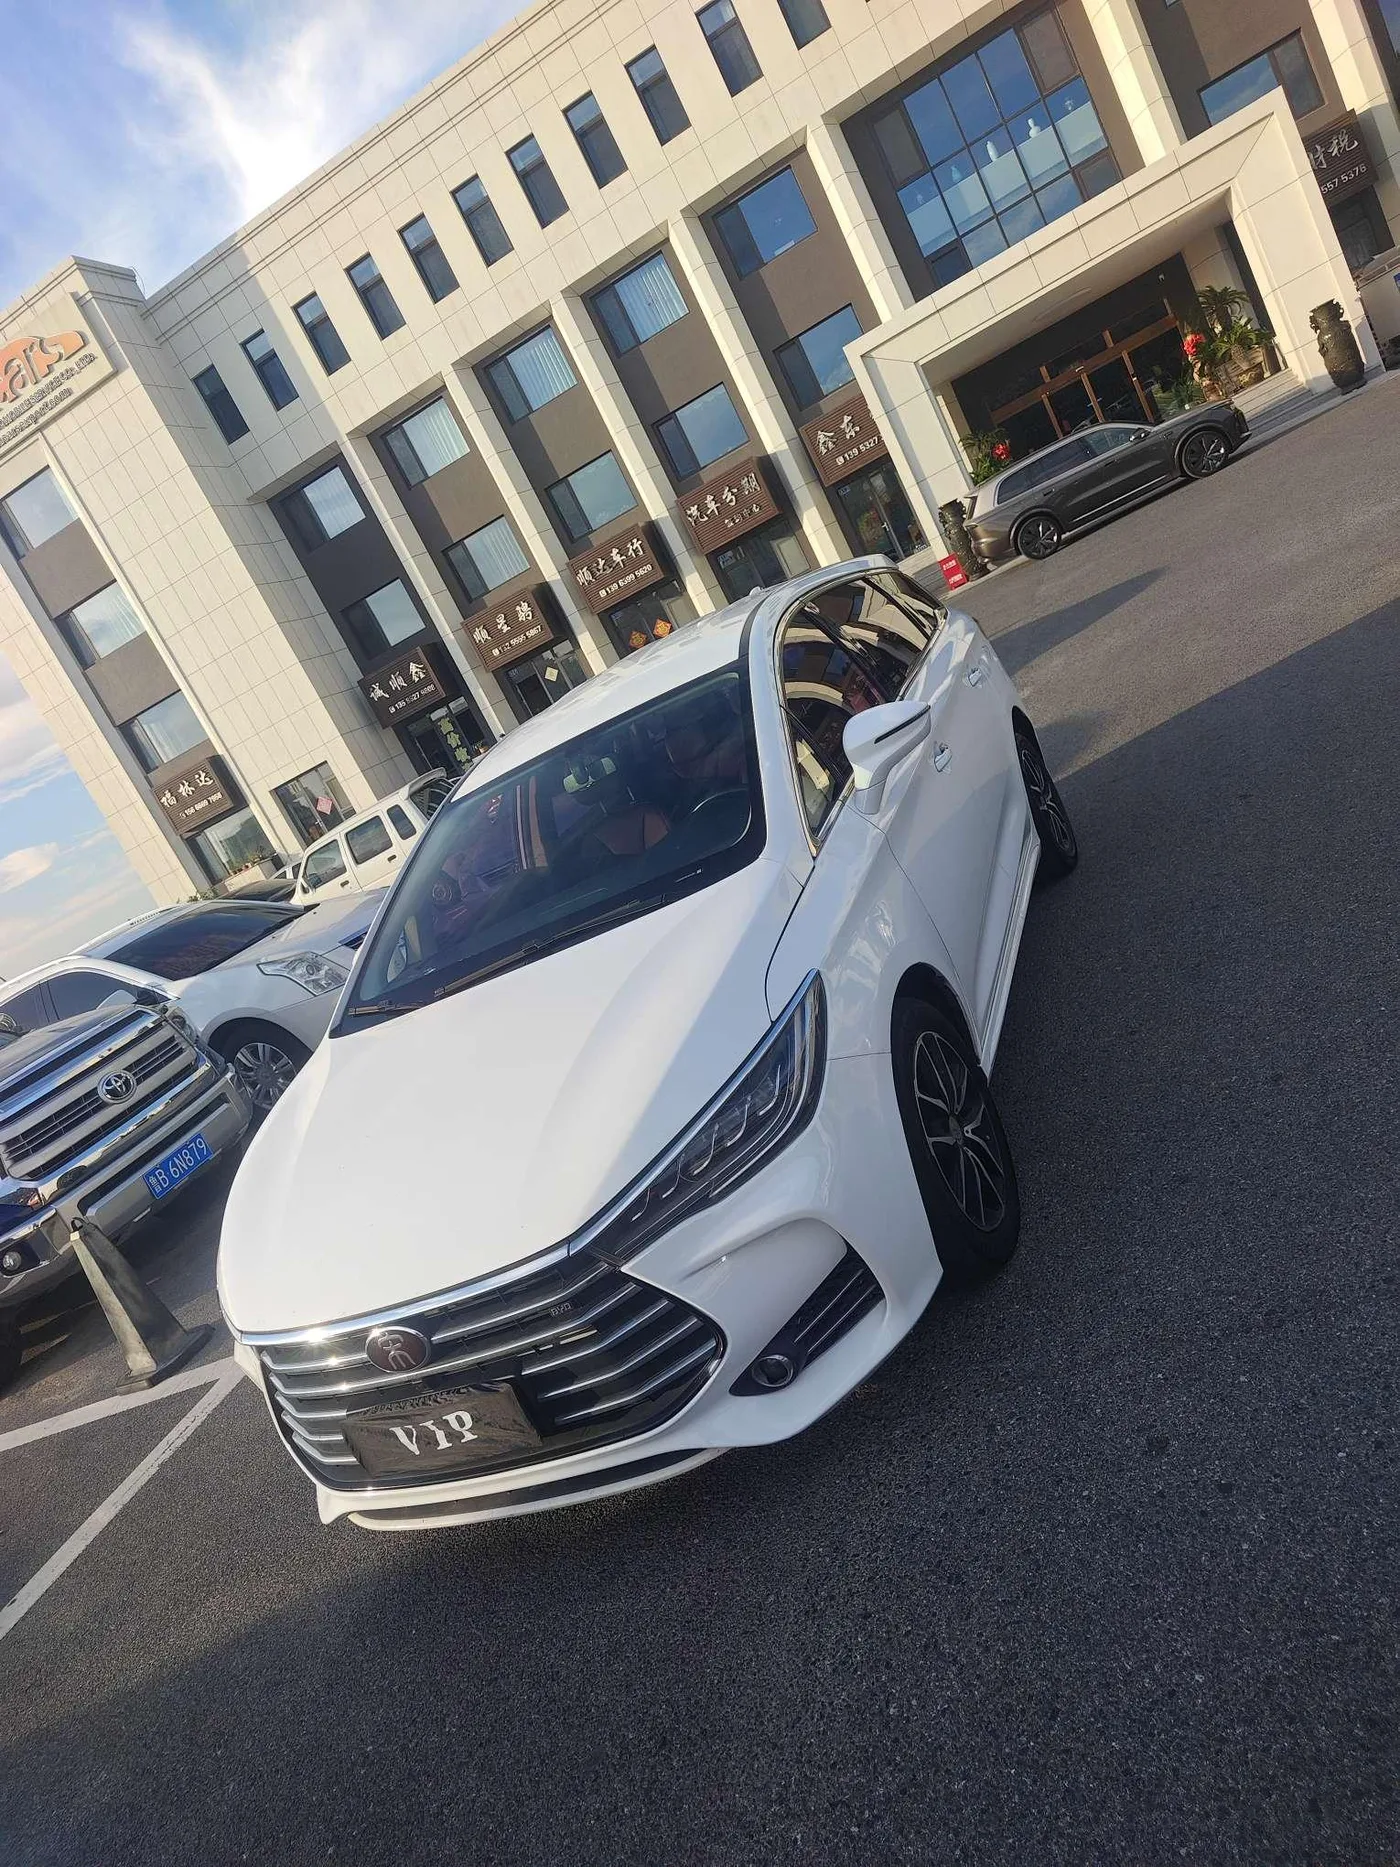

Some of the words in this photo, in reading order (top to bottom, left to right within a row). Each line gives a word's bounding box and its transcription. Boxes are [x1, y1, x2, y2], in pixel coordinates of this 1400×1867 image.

[1340, 163, 1367, 183] 5376
[844, 448, 859, 461] 139
[859, 436, 879, 452] 5327
[685, 472, 761, 526] 汽车分期
[576, 538, 644, 586] 顺达车行
[606, 583, 619, 594] 139
[635, 564, 653, 578] 5620
[526, 625, 542, 638] 5867
[369, 662, 426, 702] 诚顺鑫
[394, 699, 407, 710] 135
[160, 770, 214, 808] 福林达
[550, 1302, 571, 1317] BYD
[389, 1410, 478, 1456] VIP
